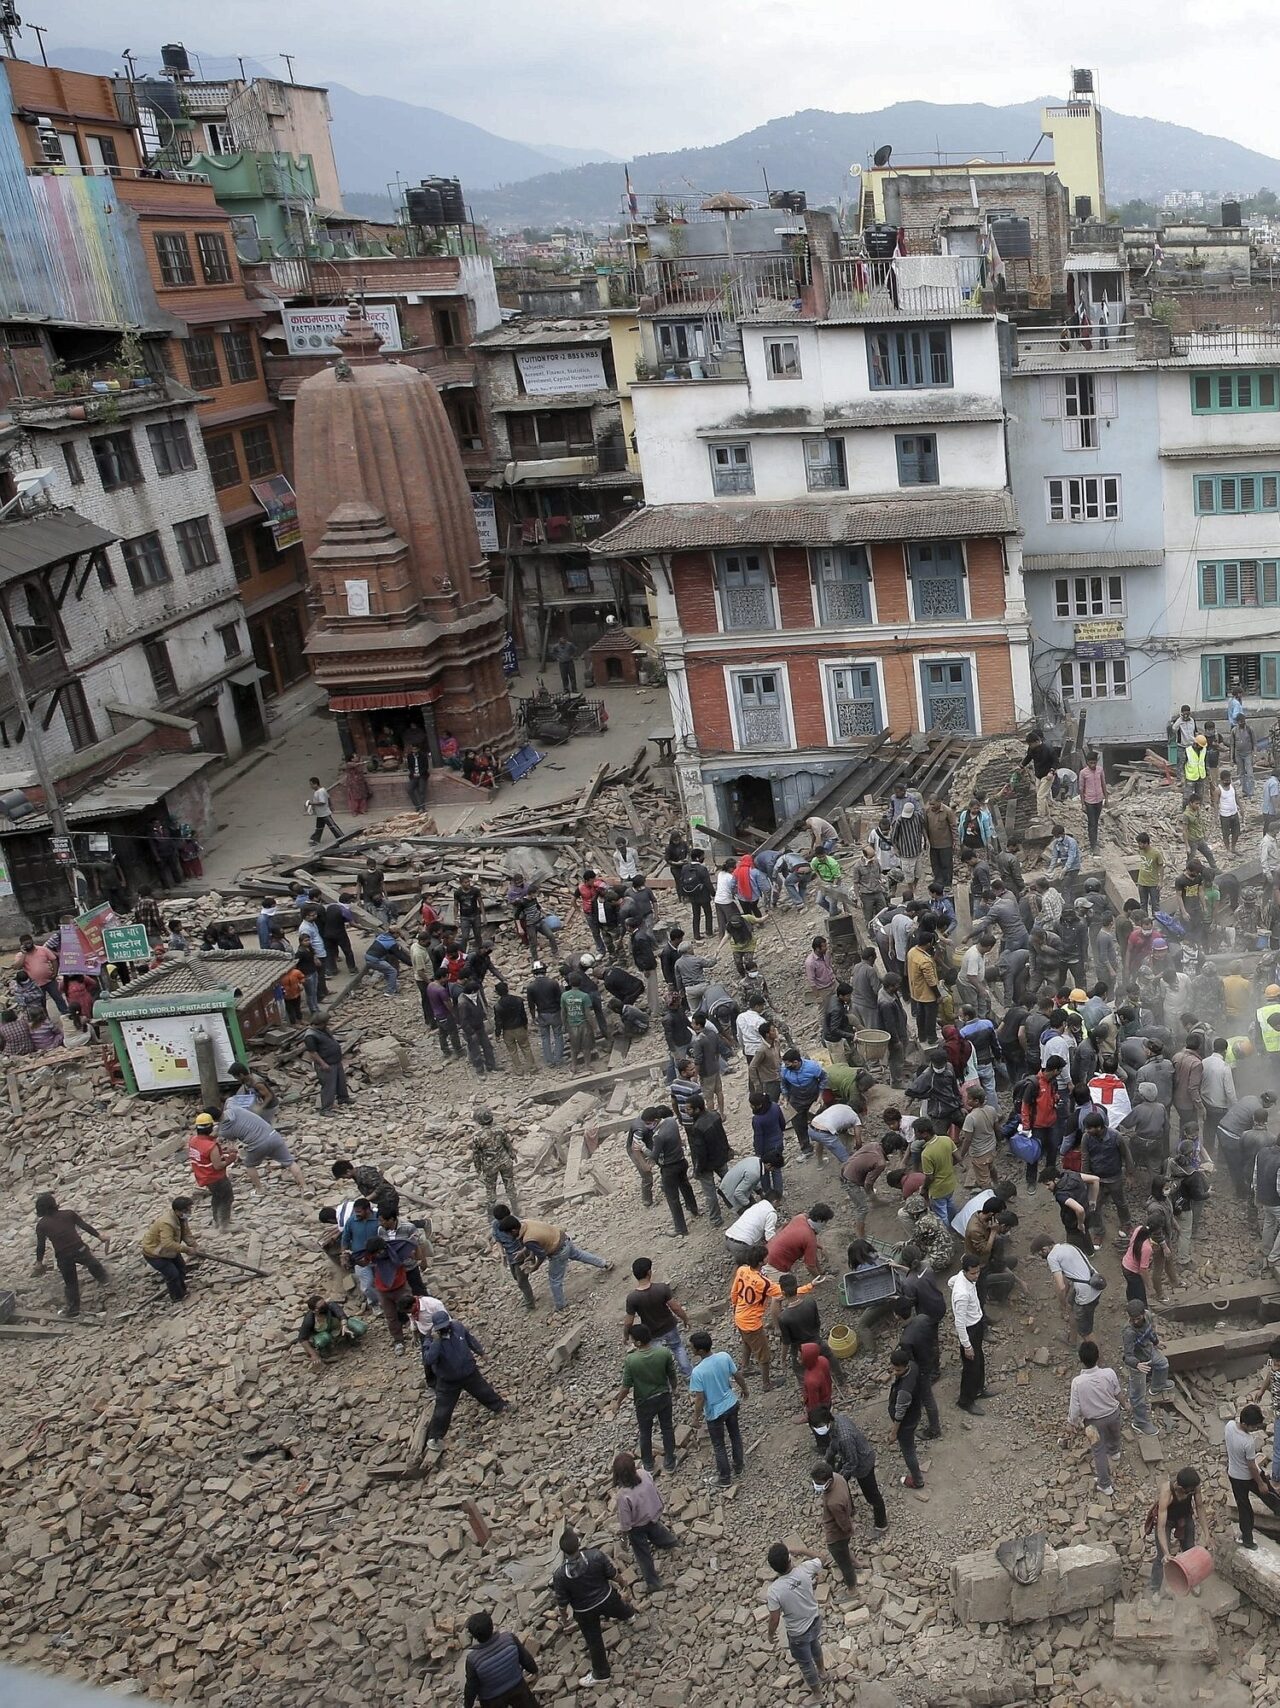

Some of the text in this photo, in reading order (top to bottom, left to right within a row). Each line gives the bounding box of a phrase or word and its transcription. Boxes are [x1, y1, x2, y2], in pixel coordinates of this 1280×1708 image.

[520, 354, 547, 364] TUITION
[546, 354, 559, 362] FOR
[567, 352, 580, 360] BBS
[113, 948, 145, 960] MARU TOL
[101, 1010, 138, 1019] WELCOME
[149, 1006, 176, 1014] WORLD
[176, 1003, 211, 1012] HERITAGE
[211, 1001, 227, 1009] SITE
